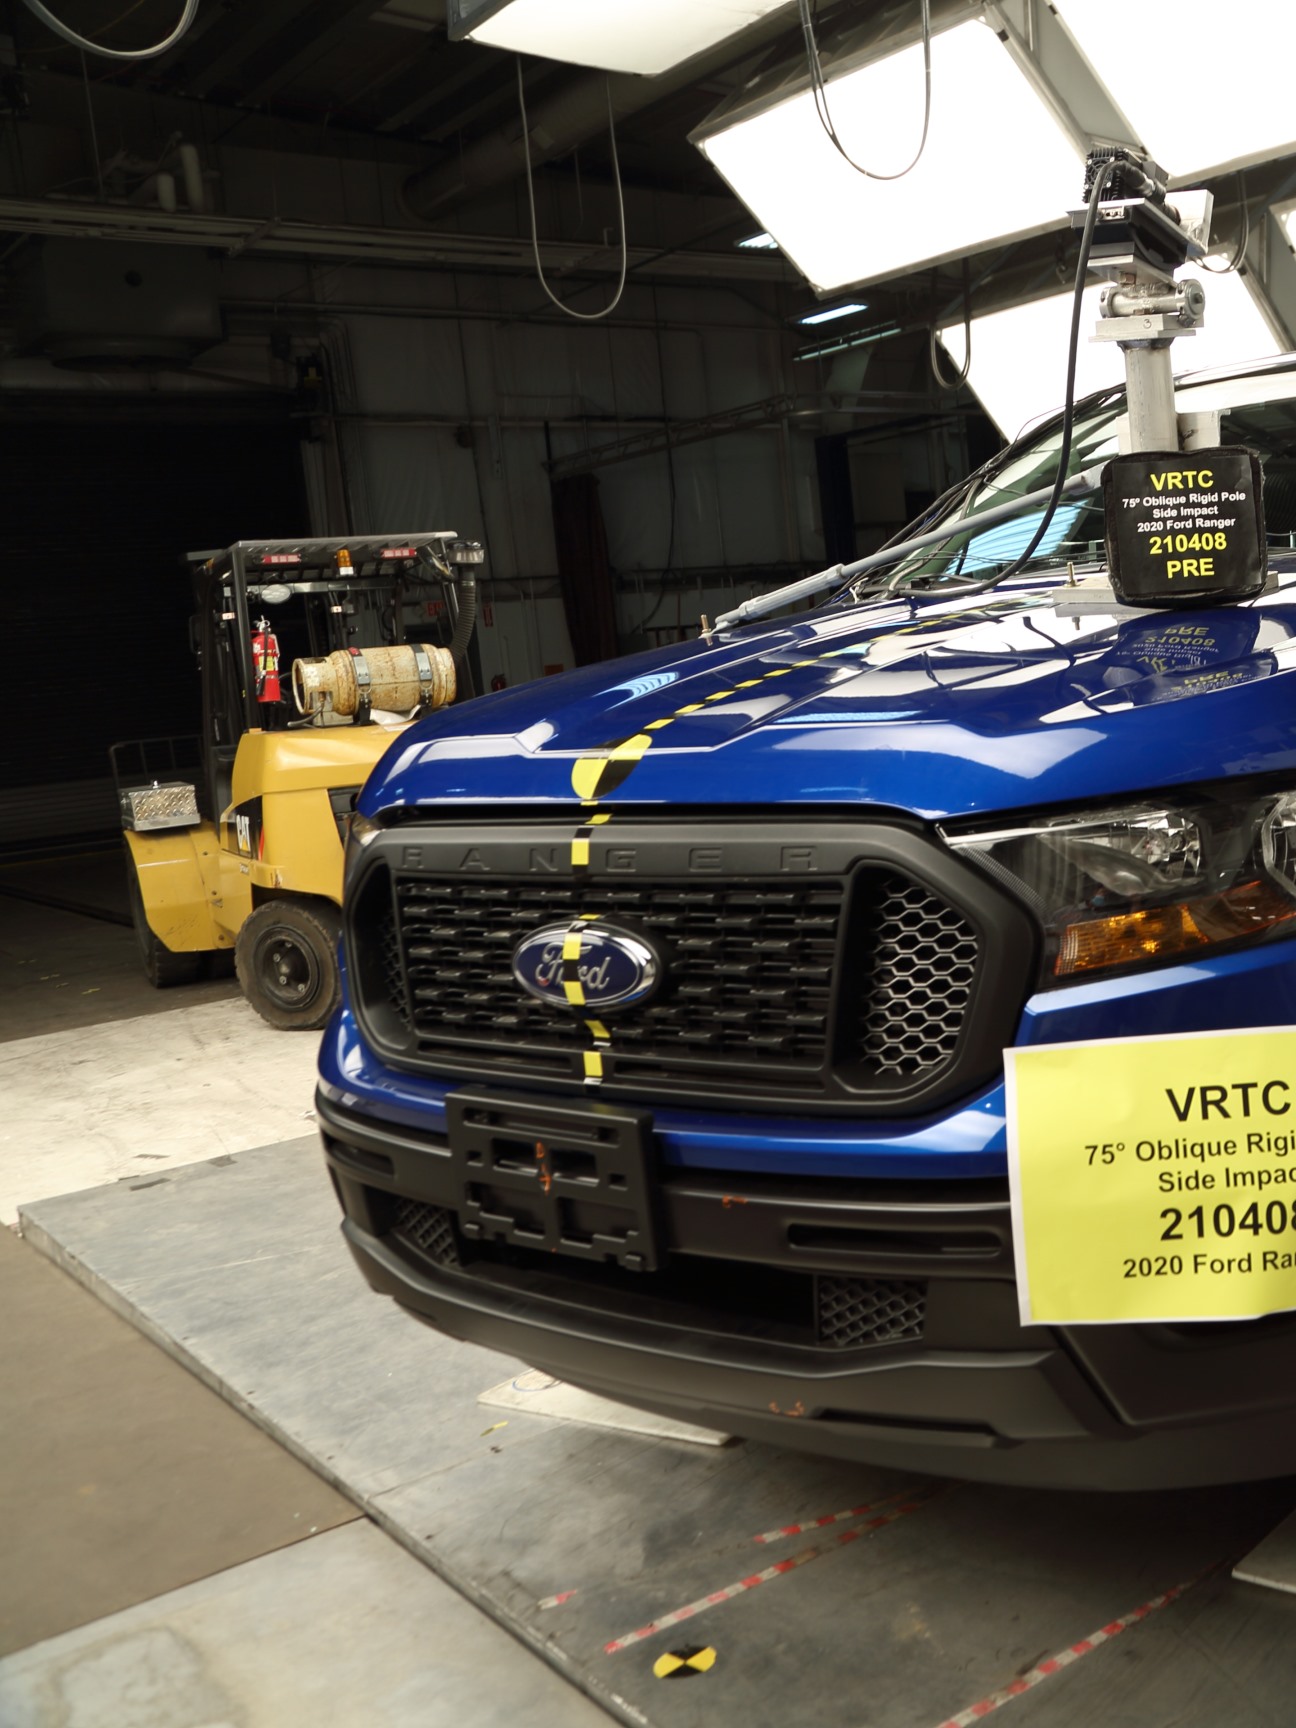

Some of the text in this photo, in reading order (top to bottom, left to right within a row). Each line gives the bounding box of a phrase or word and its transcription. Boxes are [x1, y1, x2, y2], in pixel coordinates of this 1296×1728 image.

[1142, 318, 1153, 330] 3
[1150, 470, 1214, 491] VRTC
[1142, 495, 1187, 508] Oblique
[1189, 492, 1219, 505] Rigid
[1221, 490, 1247, 502] Pole
[1152, 505, 1219, 519] Side Impact
[1137, 517, 1236, 533] 2020 Ford Ranger
[1149, 532, 1228, 555] 210408
[1166, 557, 1215, 579] PRE
[236, 814, 251, 853] CAT
[402, 845, 818, 873] RANGER
[535, 941, 612, 990] Frd
[1166, 1080, 1292, 1122] VRTC
[1085, 1142, 1125, 1166] 75°
[1136, 1139, 1237, 1162] Oblique
[1158, 1170, 1216, 1192] Side
[1124, 1256, 1183, 1278] 2020
[1194, 1252, 1252, 1274] Ford
